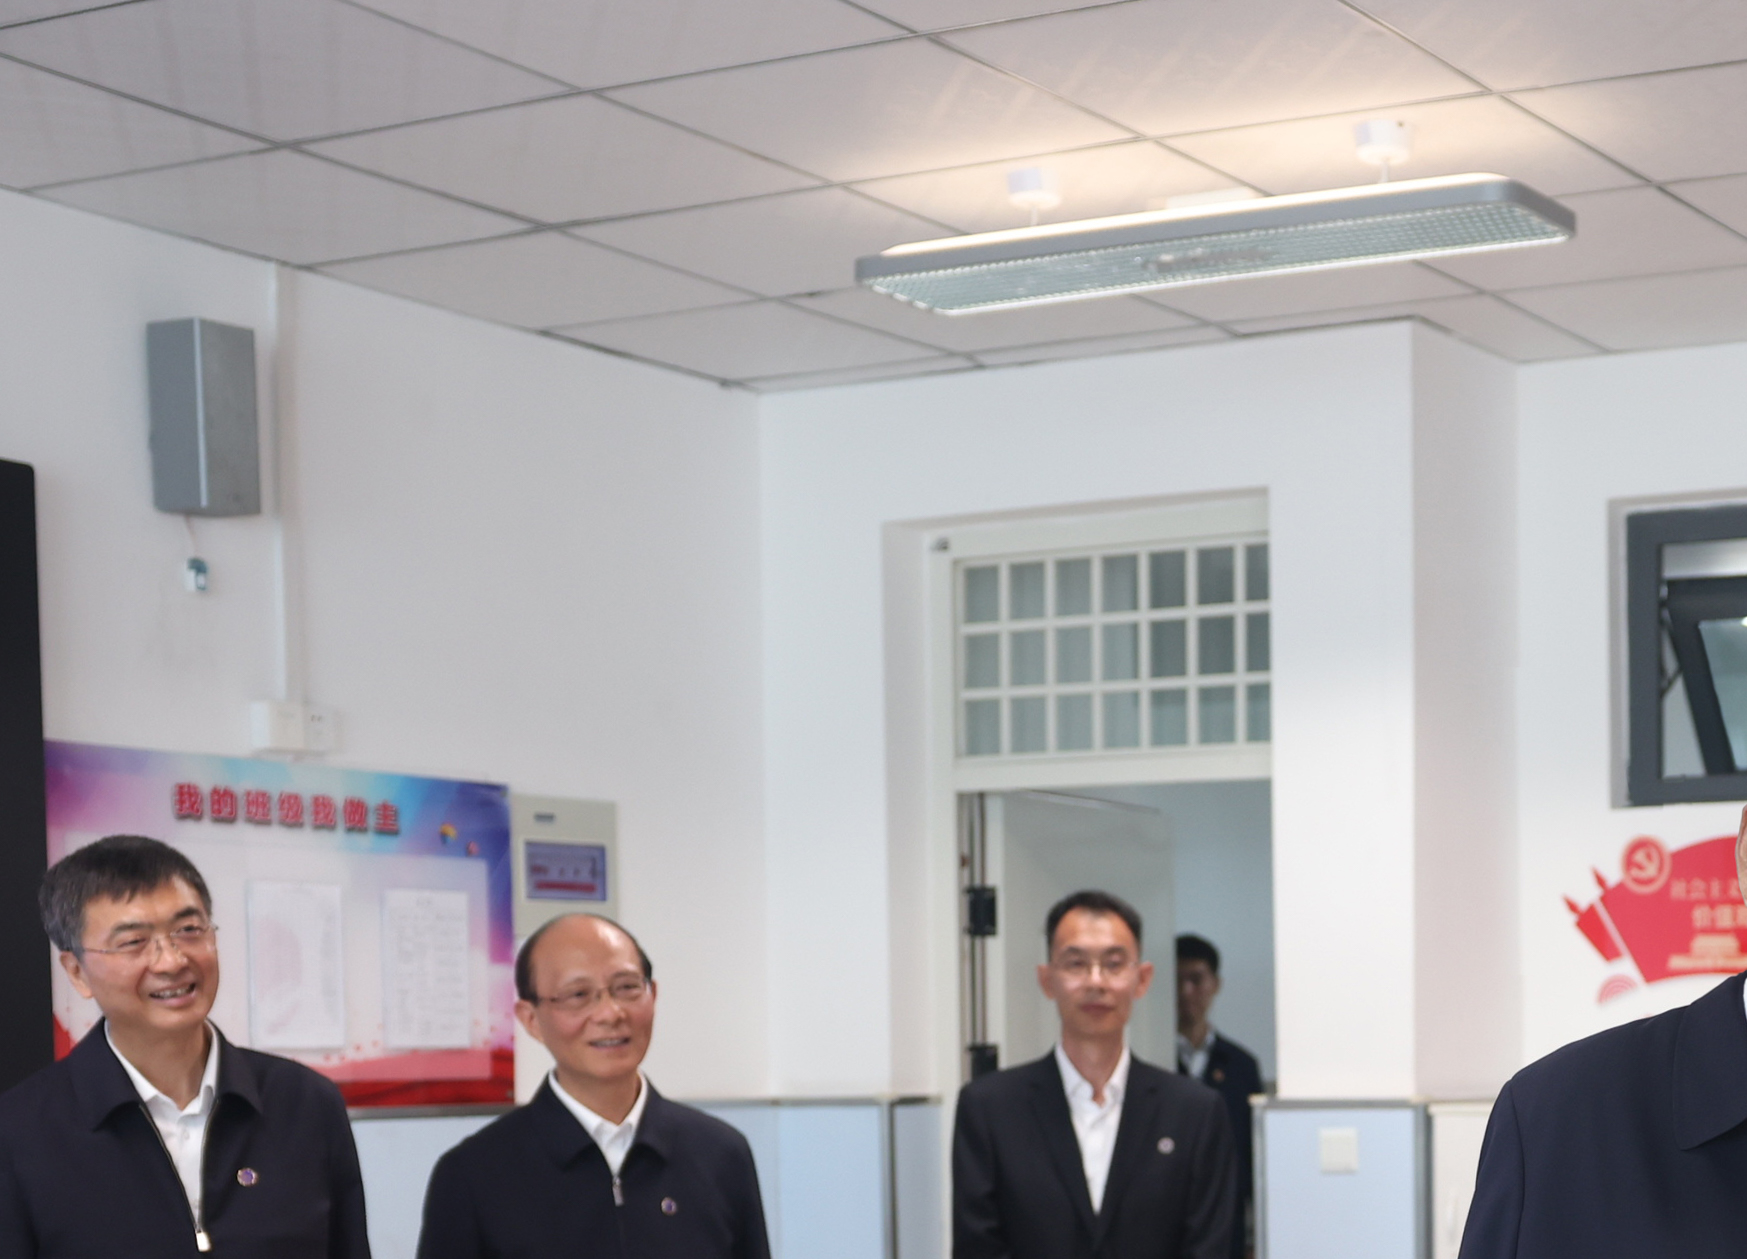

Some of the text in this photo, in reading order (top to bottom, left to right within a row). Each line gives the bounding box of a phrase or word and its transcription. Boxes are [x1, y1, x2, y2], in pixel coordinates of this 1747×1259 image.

[174, 782, 399, 832] 我的班级我做主
